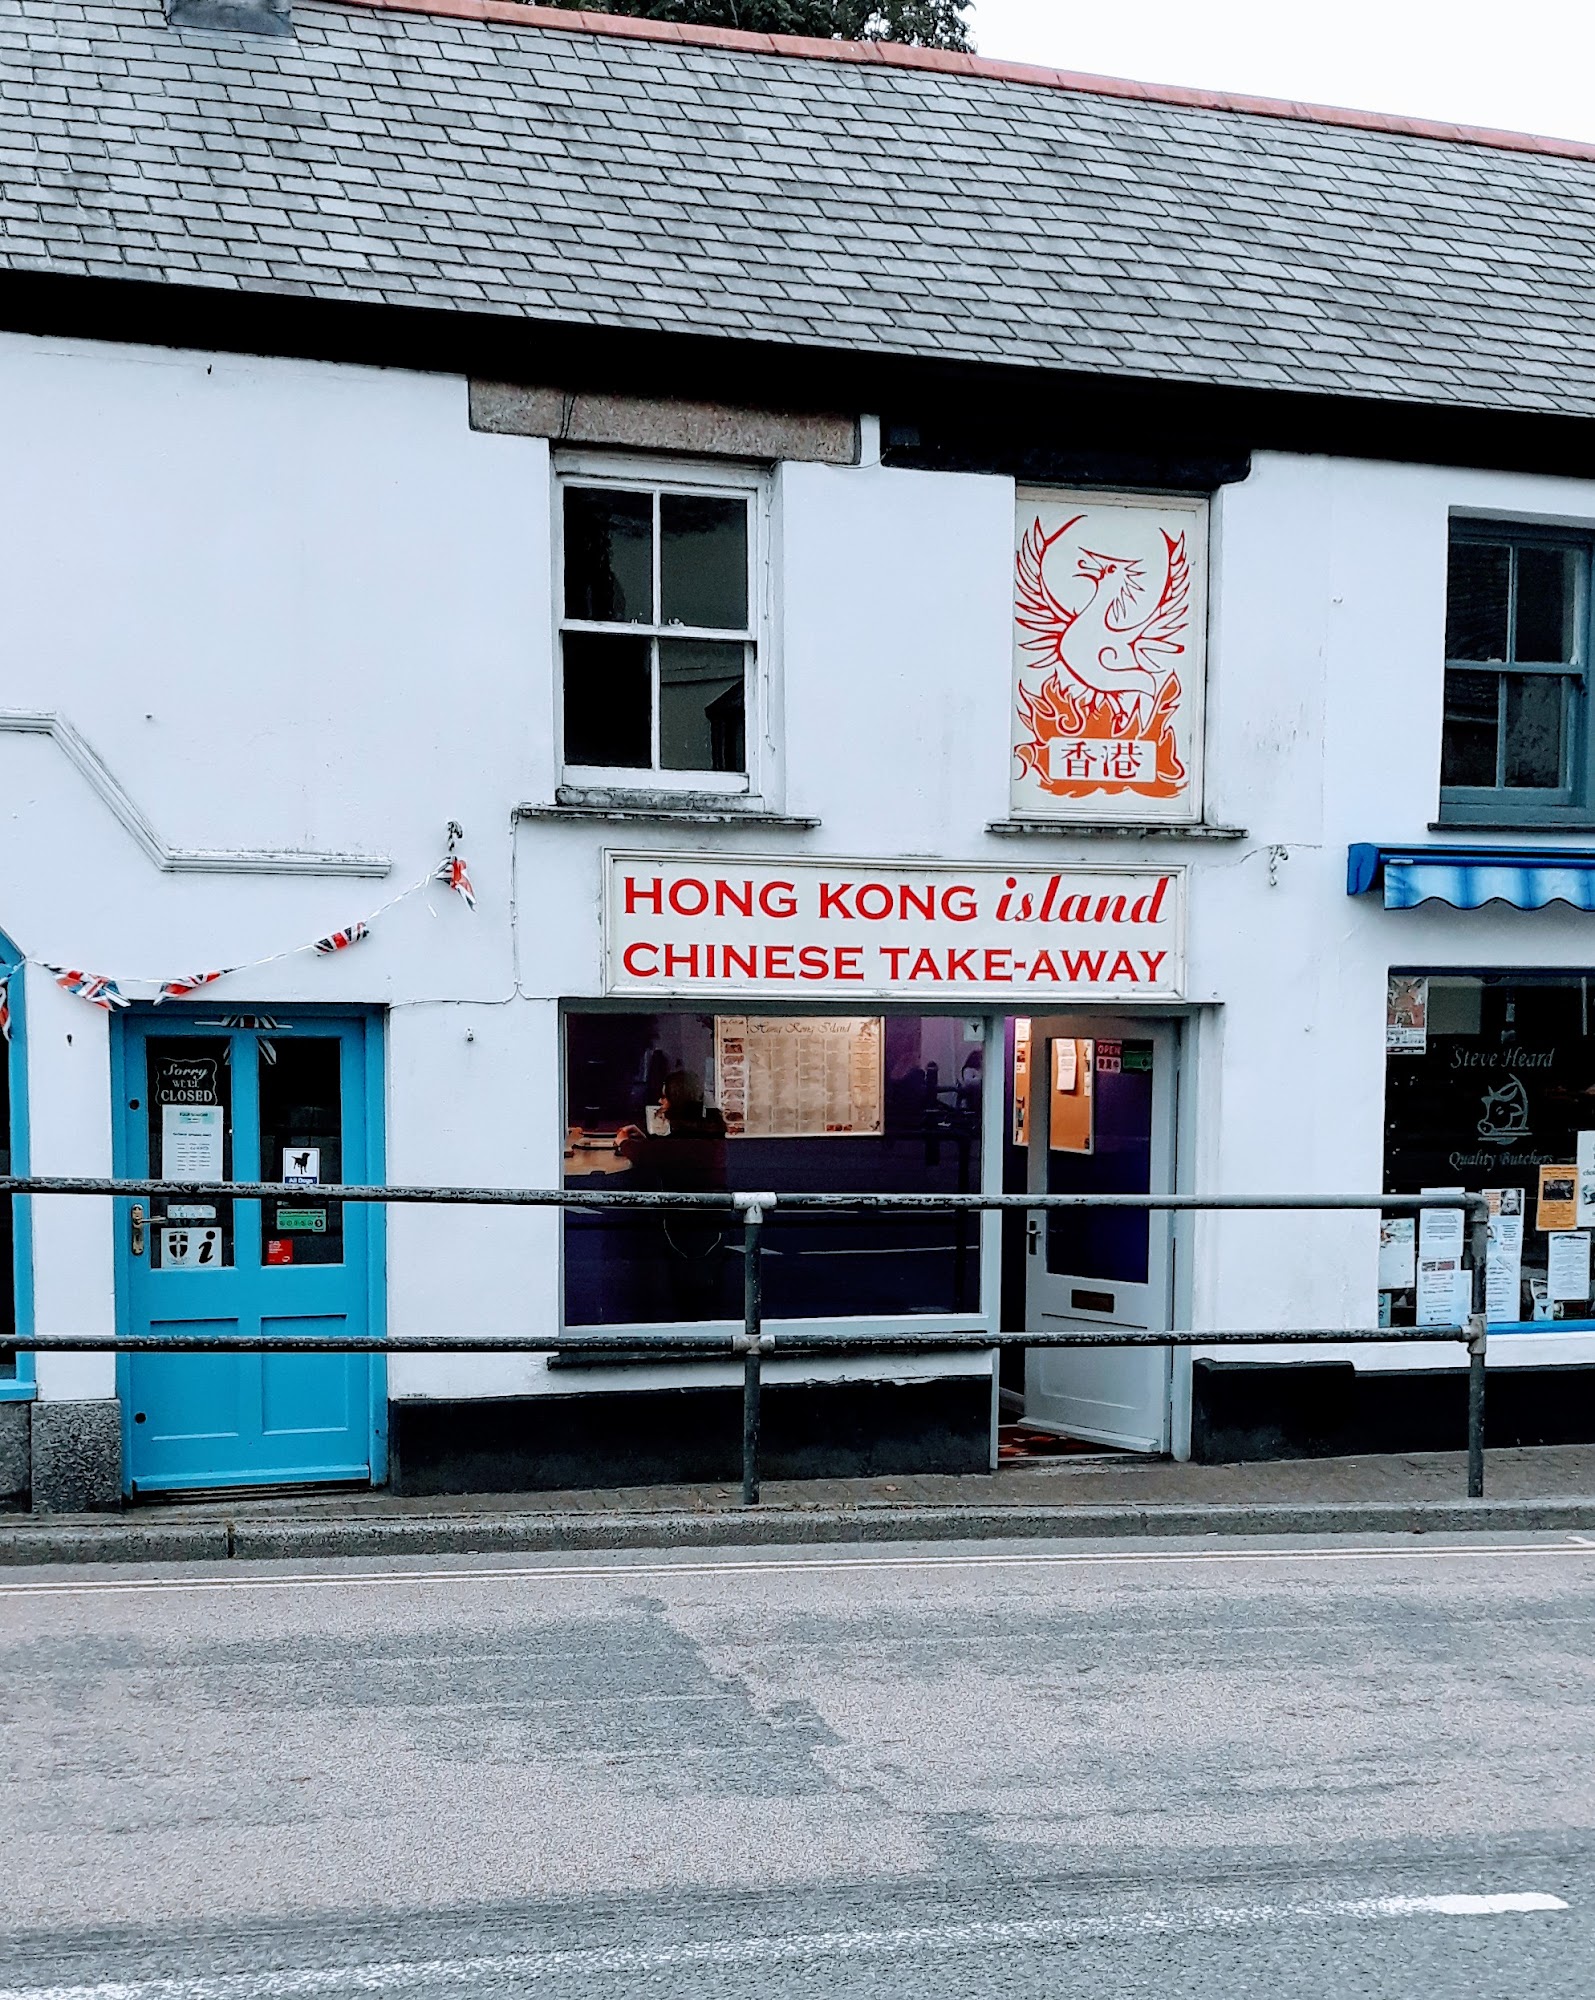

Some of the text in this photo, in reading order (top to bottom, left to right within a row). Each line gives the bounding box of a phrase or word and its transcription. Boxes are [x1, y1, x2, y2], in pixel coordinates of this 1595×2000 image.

[1060, 740, 1144, 779] 香港
[625, 875, 1168, 923] HONG KONG island
[624, 943, 1165, 982] CHINESE TAKE-AWAY
[1097, 1044, 1121, 1055] OPEN
[1450, 1045, 1556, 1068] Steve Heard
[163, 1063, 208, 1080] Sorry
[161, 1089, 213, 1102] CLOSED
[1450, 1149, 1554, 1171] Quality Butchers
